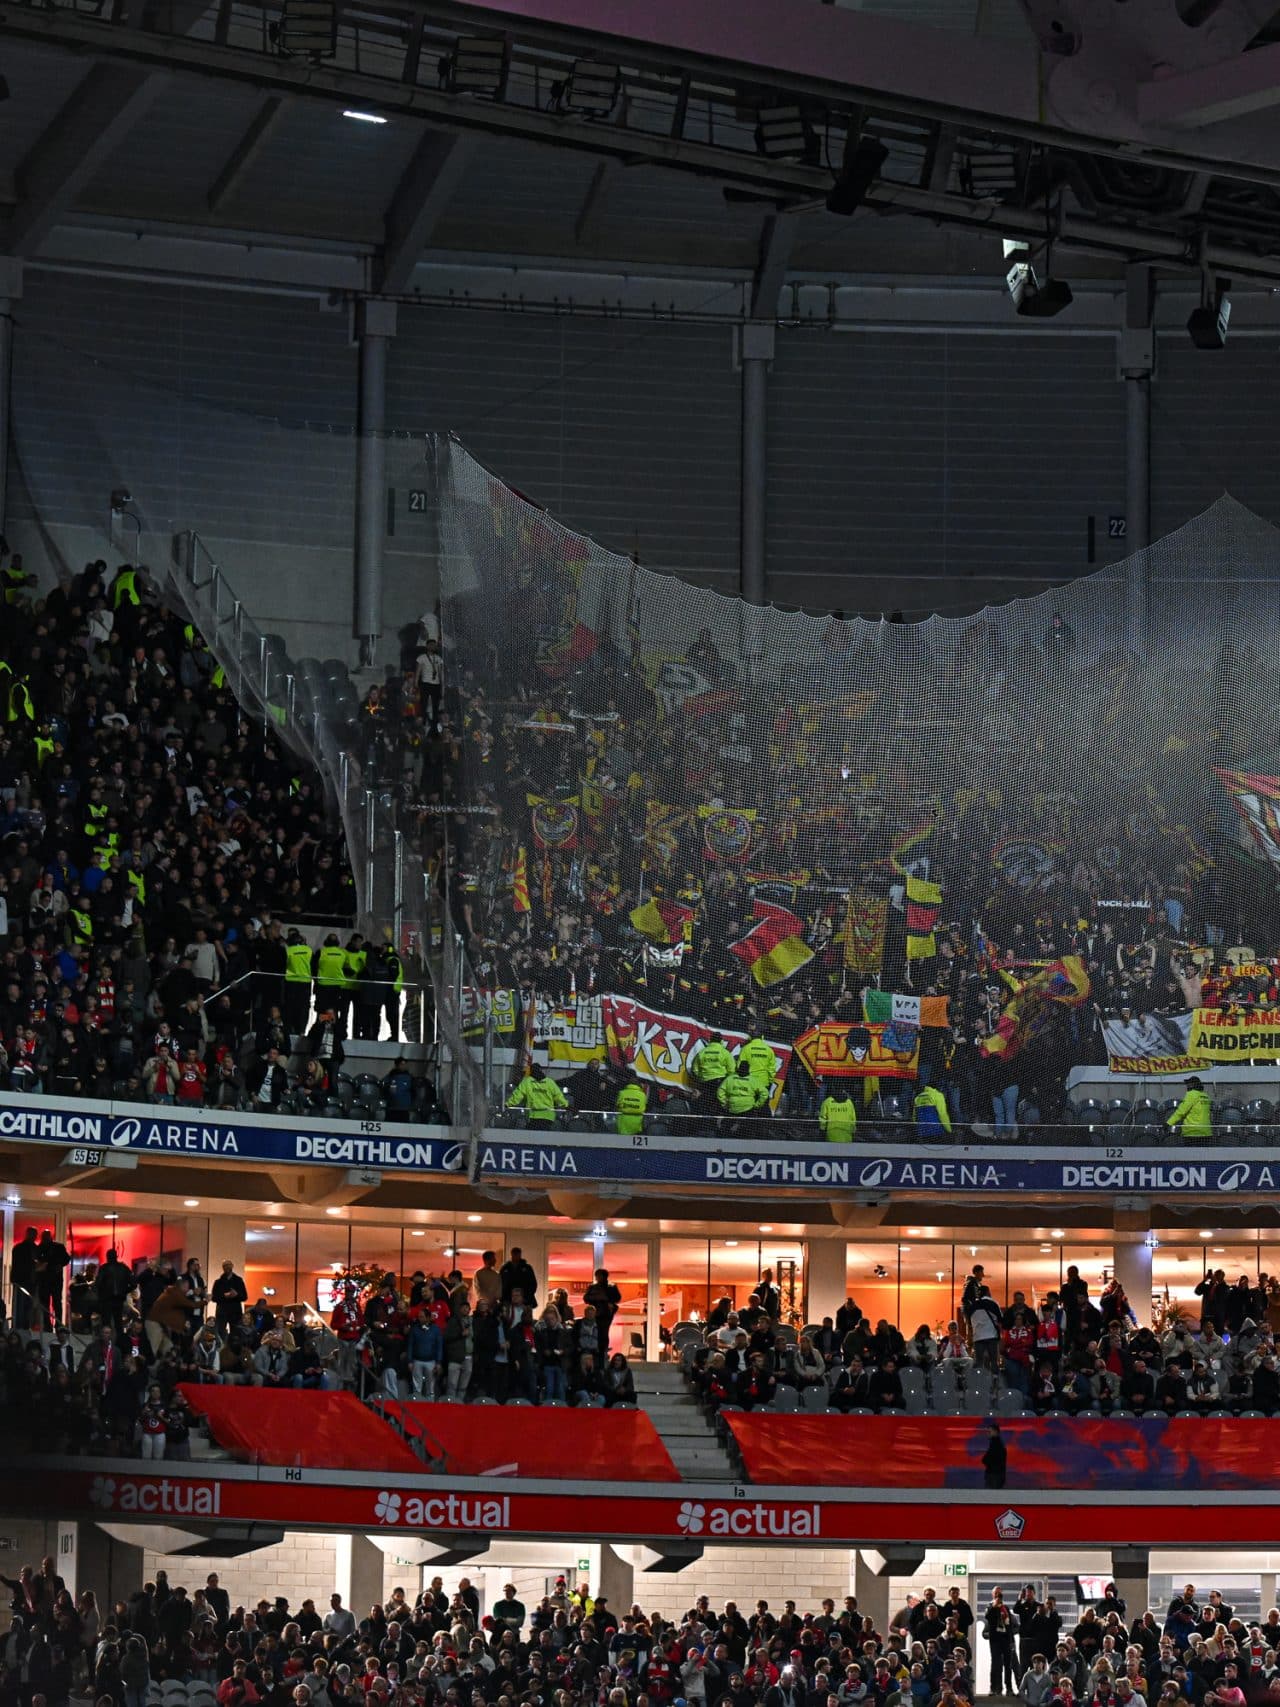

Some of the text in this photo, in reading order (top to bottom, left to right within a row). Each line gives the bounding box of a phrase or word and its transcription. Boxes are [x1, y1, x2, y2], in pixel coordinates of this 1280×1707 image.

[410, 492, 426, 510] 21
[1109, 519, 1127, 537] 22
[0, 1111, 239, 1153] CATHLON ARENA
[360, 1121, 382, 1133] H25
[74, 1150, 100, 1163] 55 55
[296, 1136, 578, 1173] DECATHLON ARENA
[706, 1157, 1000, 1186] DECATHLON ARENA
[1062, 1165, 1207, 1188] DECATHLON
[285, 1468, 301, 1481] Hd
[119, 1480, 221, 1514] actual
[405, 1494, 510, 1529] actual
[709, 1503, 821, 1536] actual
